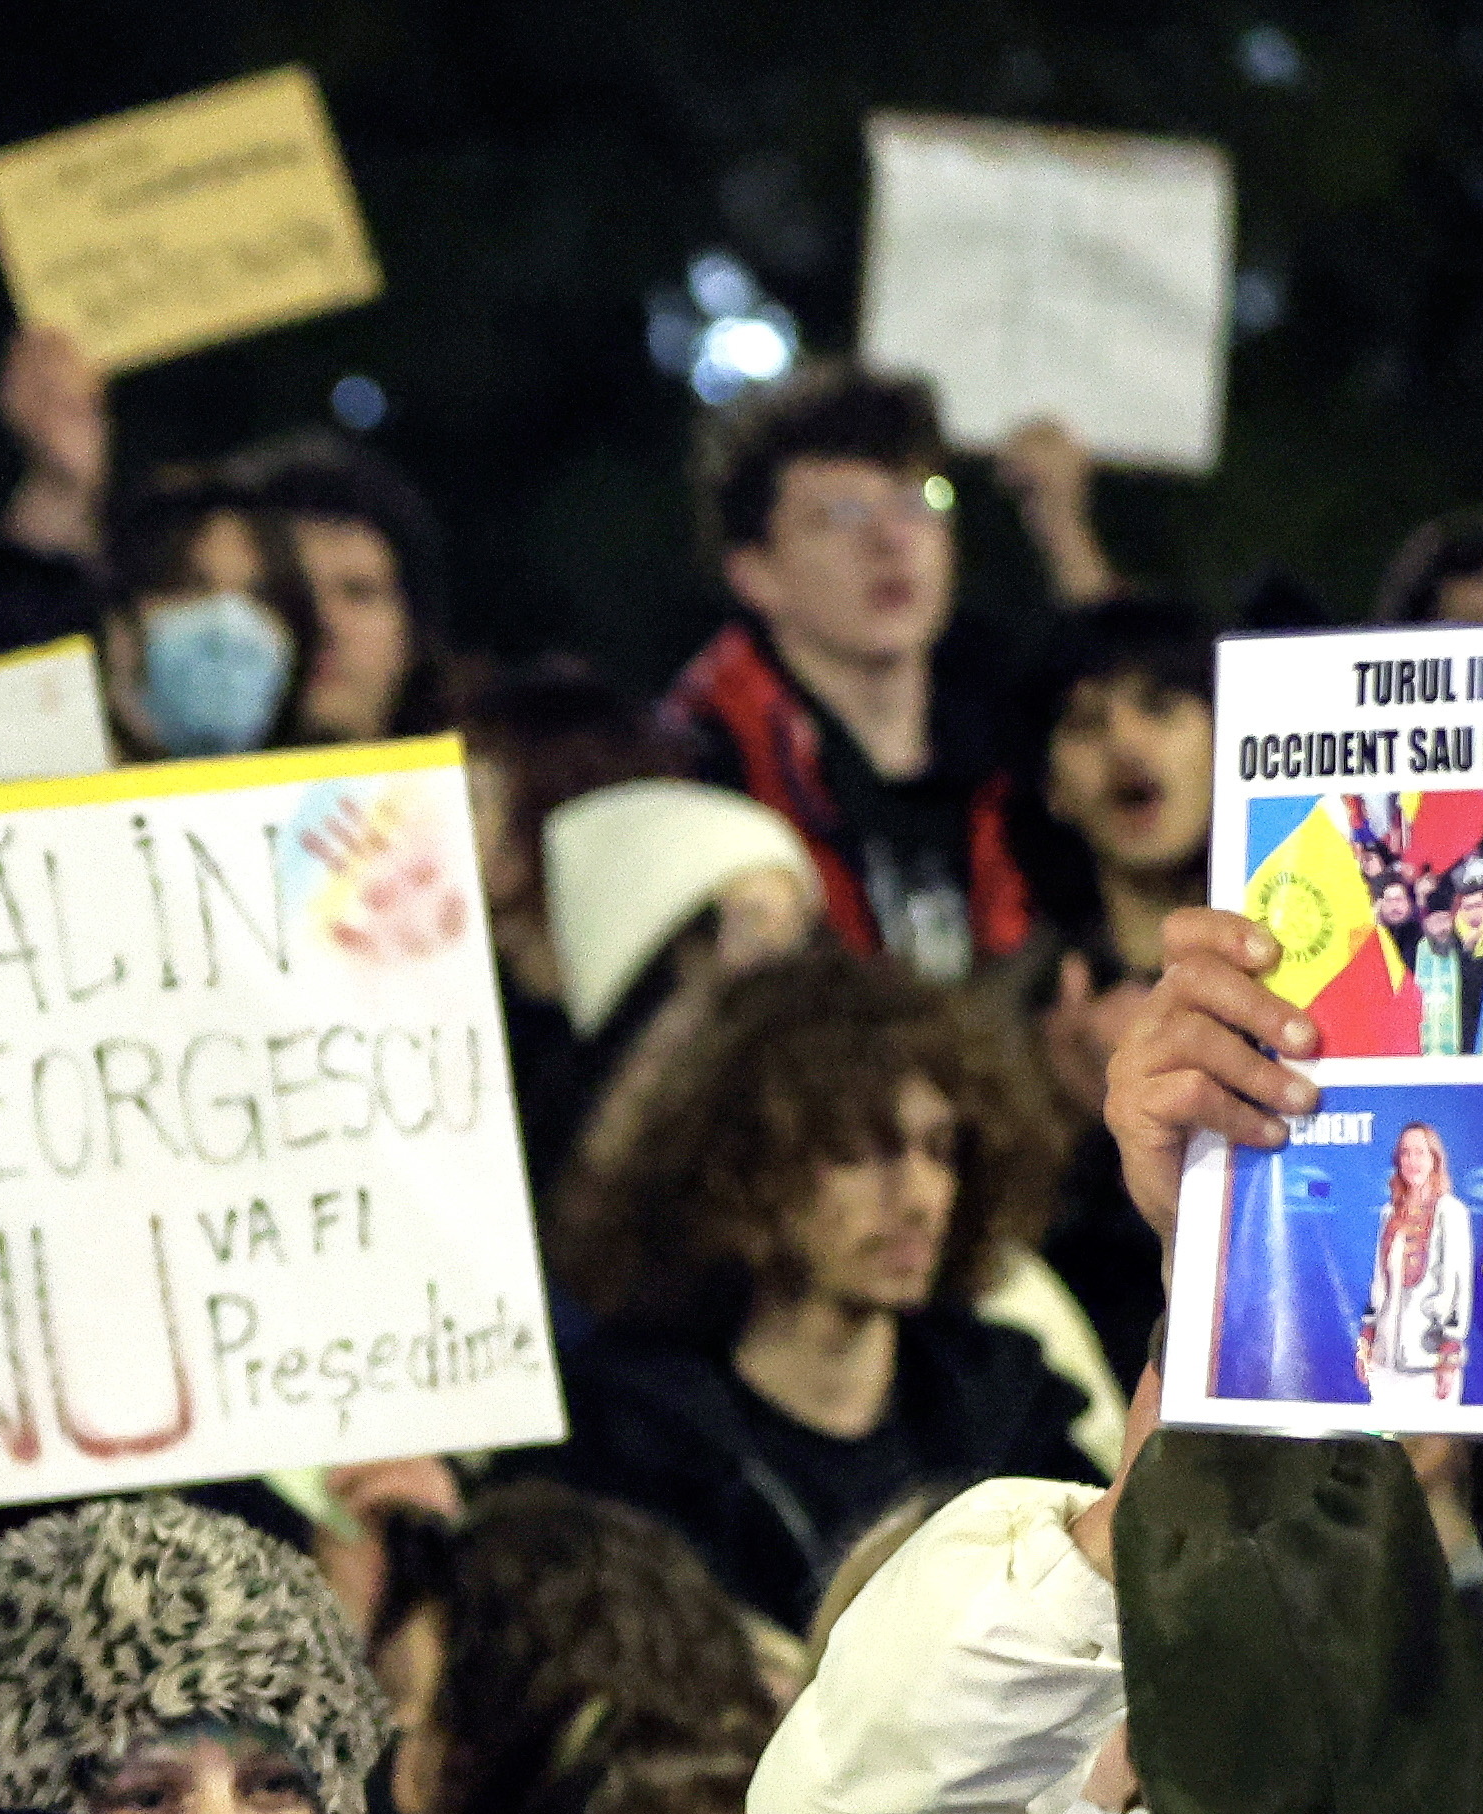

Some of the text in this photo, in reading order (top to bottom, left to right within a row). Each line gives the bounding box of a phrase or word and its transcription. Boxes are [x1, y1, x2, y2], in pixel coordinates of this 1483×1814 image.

[1352, 657, 1458, 708] TURUL
[1239, 727, 1399, 781] OCCIDENT
[1408, 725, 1474, 775] SAU
[196, 1185, 372, 1266] VA FI
